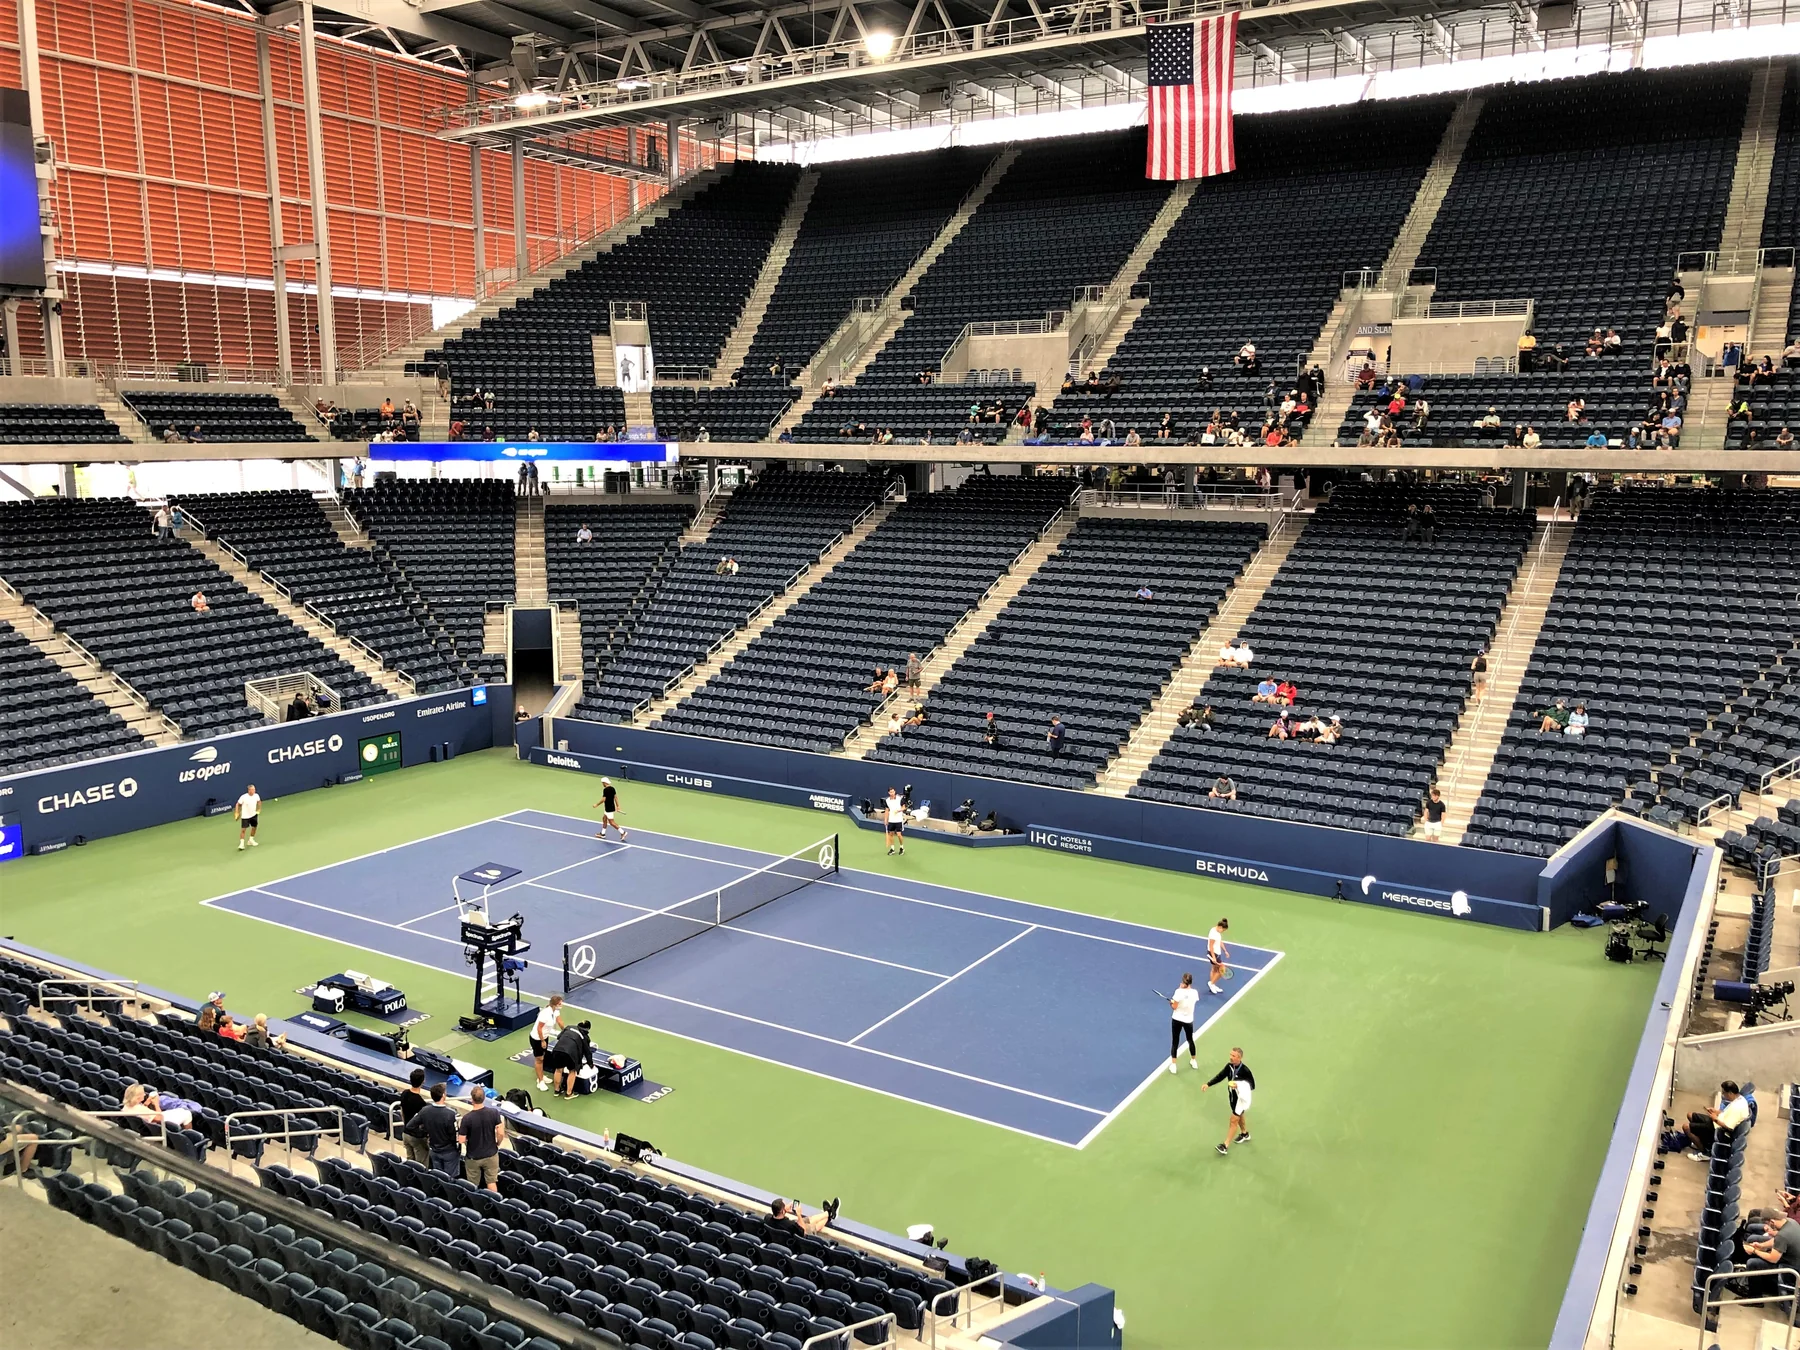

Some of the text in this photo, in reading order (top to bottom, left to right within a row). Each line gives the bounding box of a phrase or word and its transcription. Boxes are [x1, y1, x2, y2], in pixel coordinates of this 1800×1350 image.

[1356, 326, 1373, 334] AND
[362, 711, 396, 723] USOPEN.ORG
[417, 701, 466, 718] Emirates Airline
[268, 739, 326, 764] CHASE
[382, 741, 398, 749] ROLEX
[179, 761, 232, 783] us open
[666, 773, 713, 788] CHUBB
[38, 783, 116, 814] CHASE
[809, 794, 844, 805] AMERICAN
[813, 801, 845, 812] EXPRESS
[1030, 830, 1058, 846] IHG
[1060, 836, 1087, 845] HOTELS
[1060, 842, 1092, 853] RESORTS
[1196, 859, 1269, 882] BERMUDA
[384, 997, 406, 1014] POLO
[400, 1013, 431, 1028] POLO
[621, 1067, 642, 1087] POLO
[641, 1086, 673, 1104] POLO
